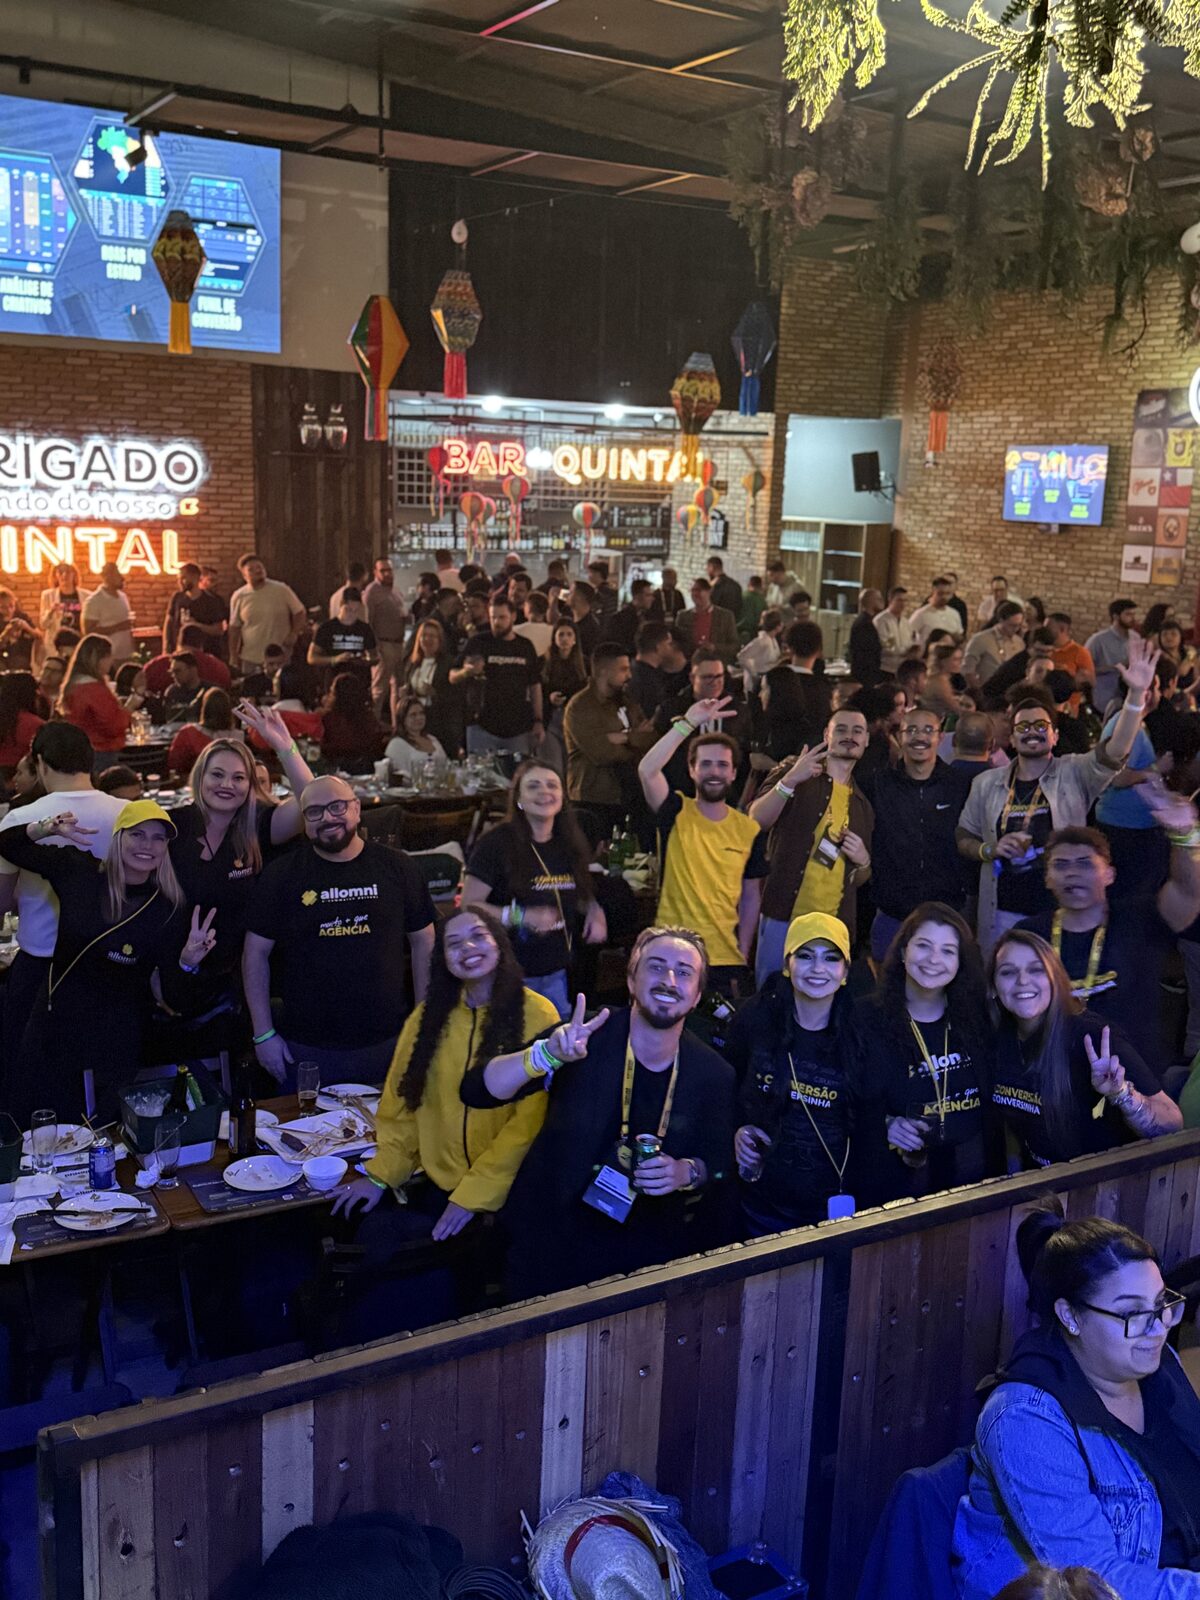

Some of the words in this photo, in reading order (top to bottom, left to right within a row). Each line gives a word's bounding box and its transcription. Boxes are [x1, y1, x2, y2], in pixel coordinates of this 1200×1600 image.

[442, 440, 527, 476] BAR
[58, 493, 90, 512] do
[98, 497, 173, 516] nosso
[0, 524, 186, 575] INTAL
[320, 884, 379, 900] allomni
